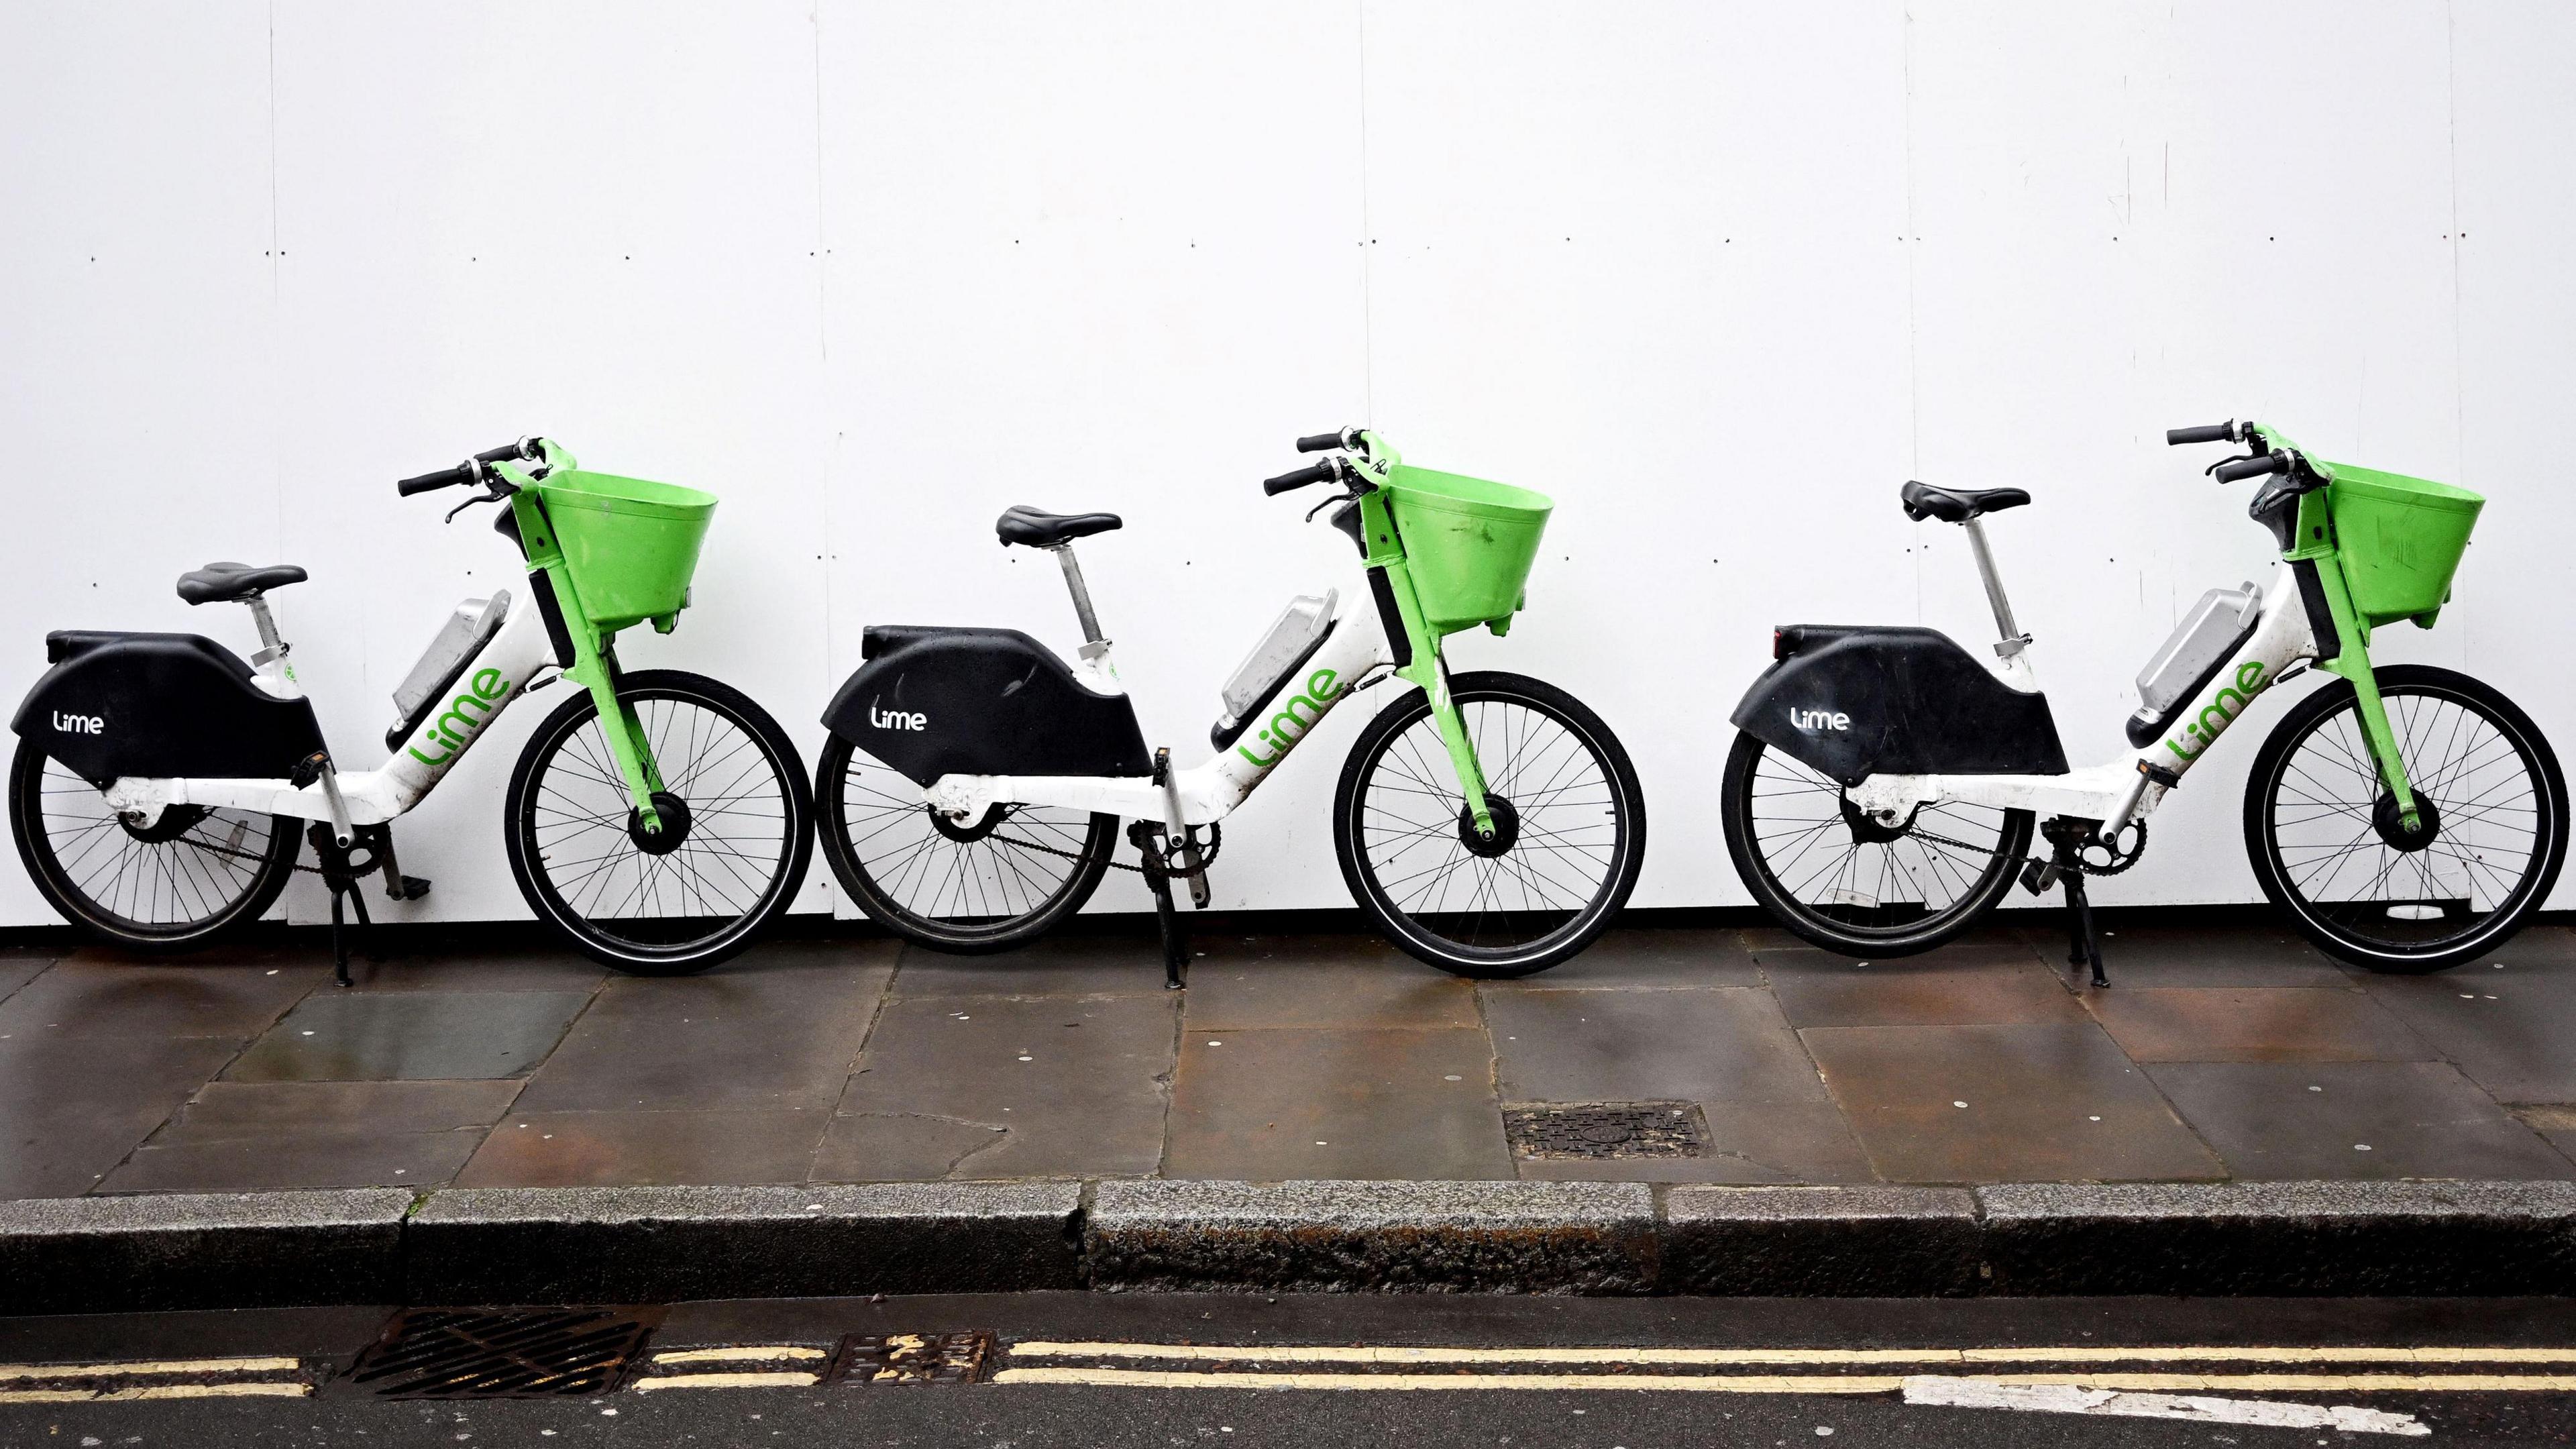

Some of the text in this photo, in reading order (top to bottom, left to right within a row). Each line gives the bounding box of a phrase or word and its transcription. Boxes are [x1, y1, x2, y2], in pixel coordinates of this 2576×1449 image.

[53, 710, 105, 735] Lime
[409, 668, 510, 765] Lime
[871, 707, 928, 731] Lime
[1238, 668, 1342, 766] Lime
[1790, 707, 1849, 731] Lime
[2165, 661, 2268, 761] Lime
